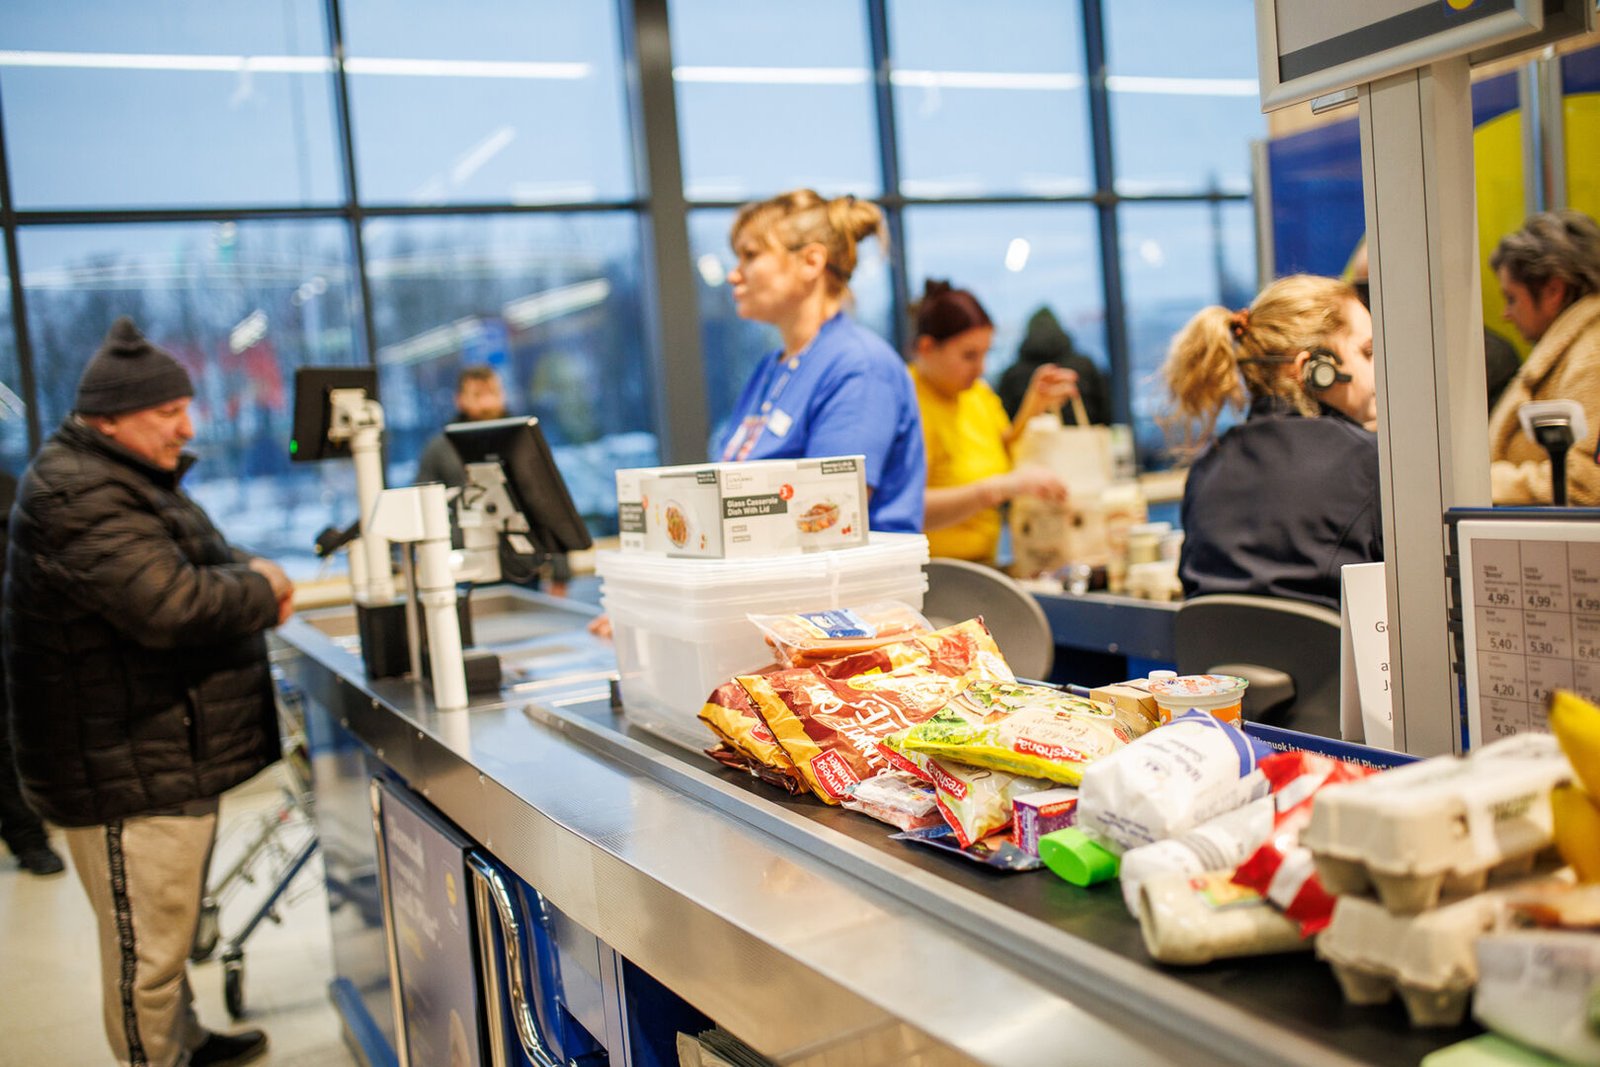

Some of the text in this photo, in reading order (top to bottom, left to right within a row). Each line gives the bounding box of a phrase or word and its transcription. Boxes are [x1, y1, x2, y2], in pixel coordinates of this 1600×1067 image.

[726, 496, 778, 508] Glass Casserole
[727, 504, 770, 516] Dish With Lid
[1488, 592, 1510, 606] 4,99
[1527, 595, 1551, 609] 4,99
[1375, 621, 1389, 633] G
[1490, 637, 1512, 650] 5,40
[1530, 640, 1553, 654] 5,30
[1493, 683, 1515, 697] 4,20
[849, 699, 902, 735] IES
[1017, 738, 1083, 762] Freshona
[816, 759, 846, 796] arvest
